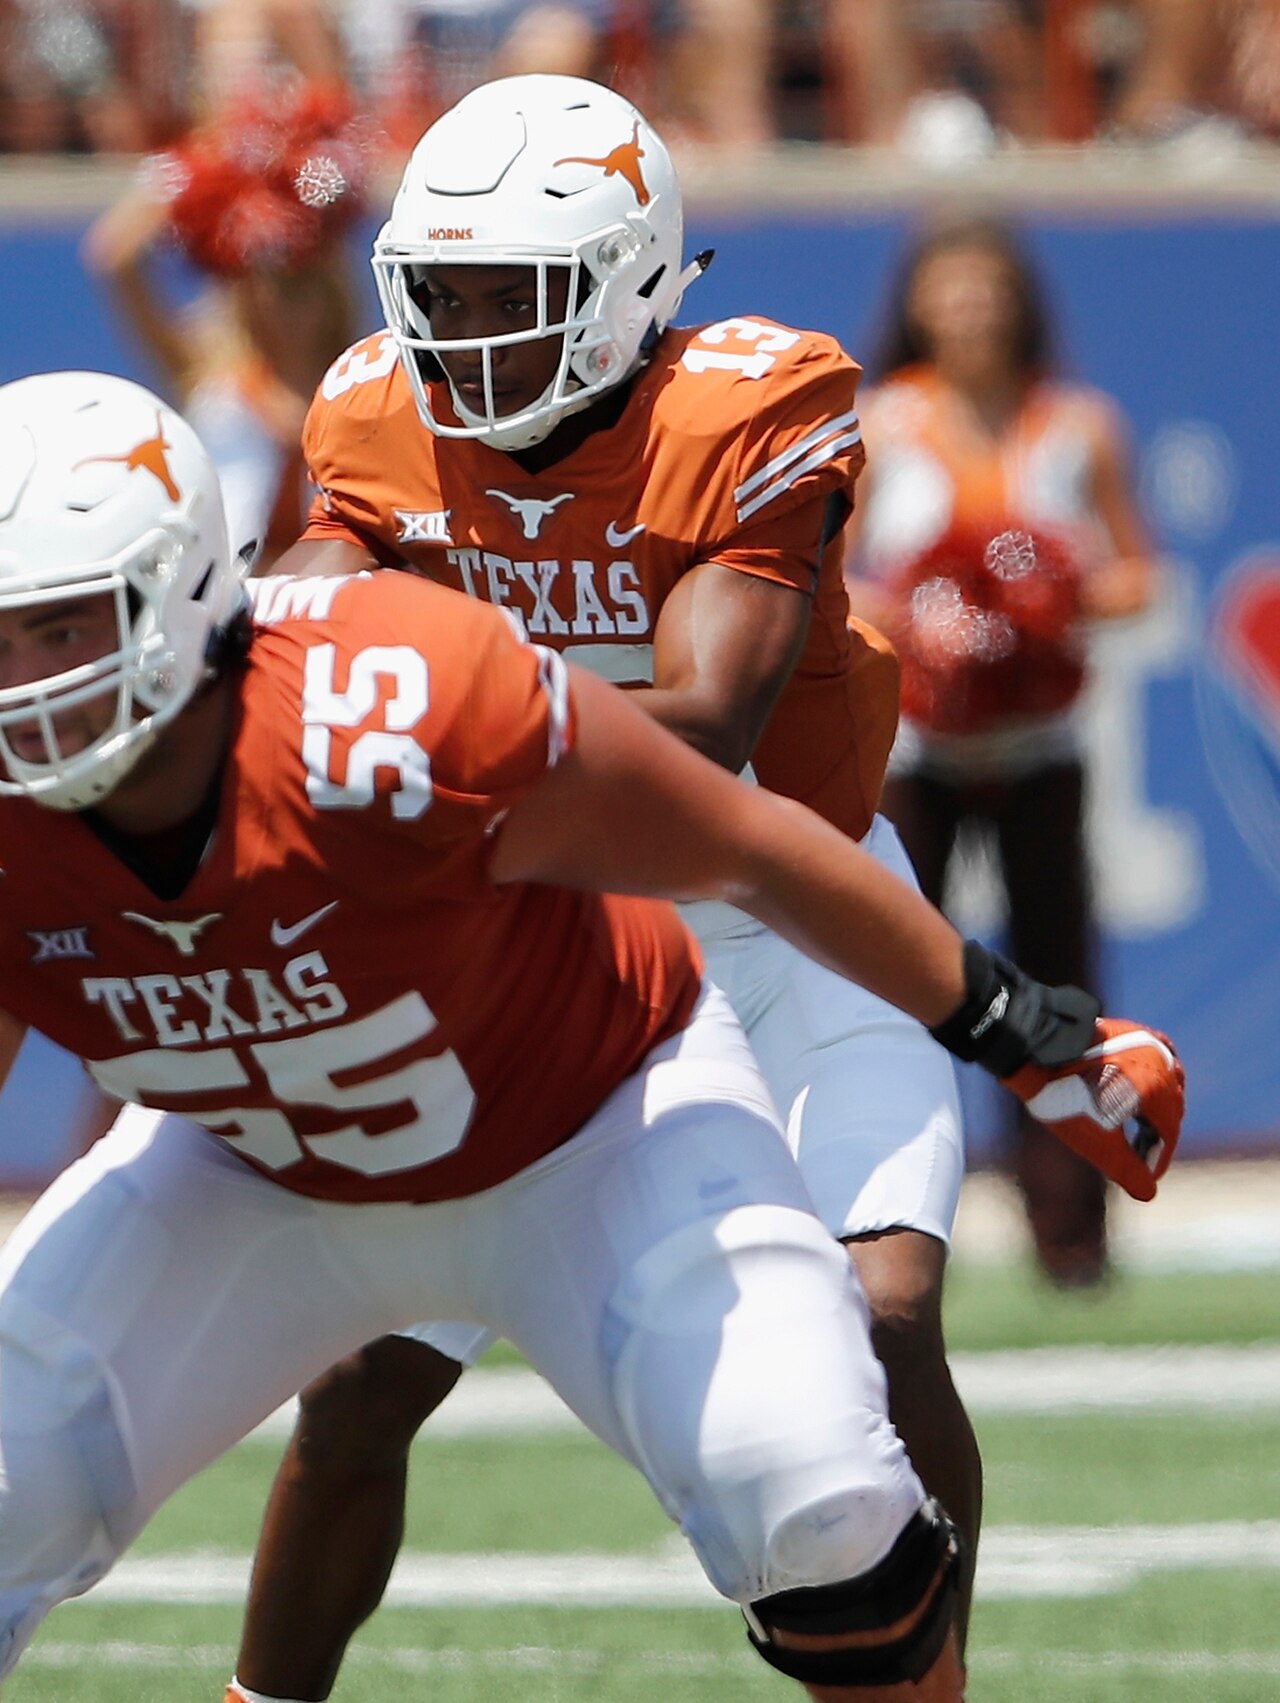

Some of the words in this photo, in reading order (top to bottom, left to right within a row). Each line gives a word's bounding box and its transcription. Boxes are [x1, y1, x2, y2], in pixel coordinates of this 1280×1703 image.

[427, 227, 474, 241] HORNS
[681, 318, 801, 379] 13
[446, 548, 651, 636] TEXAS
[301, 641, 434, 821] 55
[81, 950, 349, 1047] TEXAS
[85, 990, 477, 1178] 55
